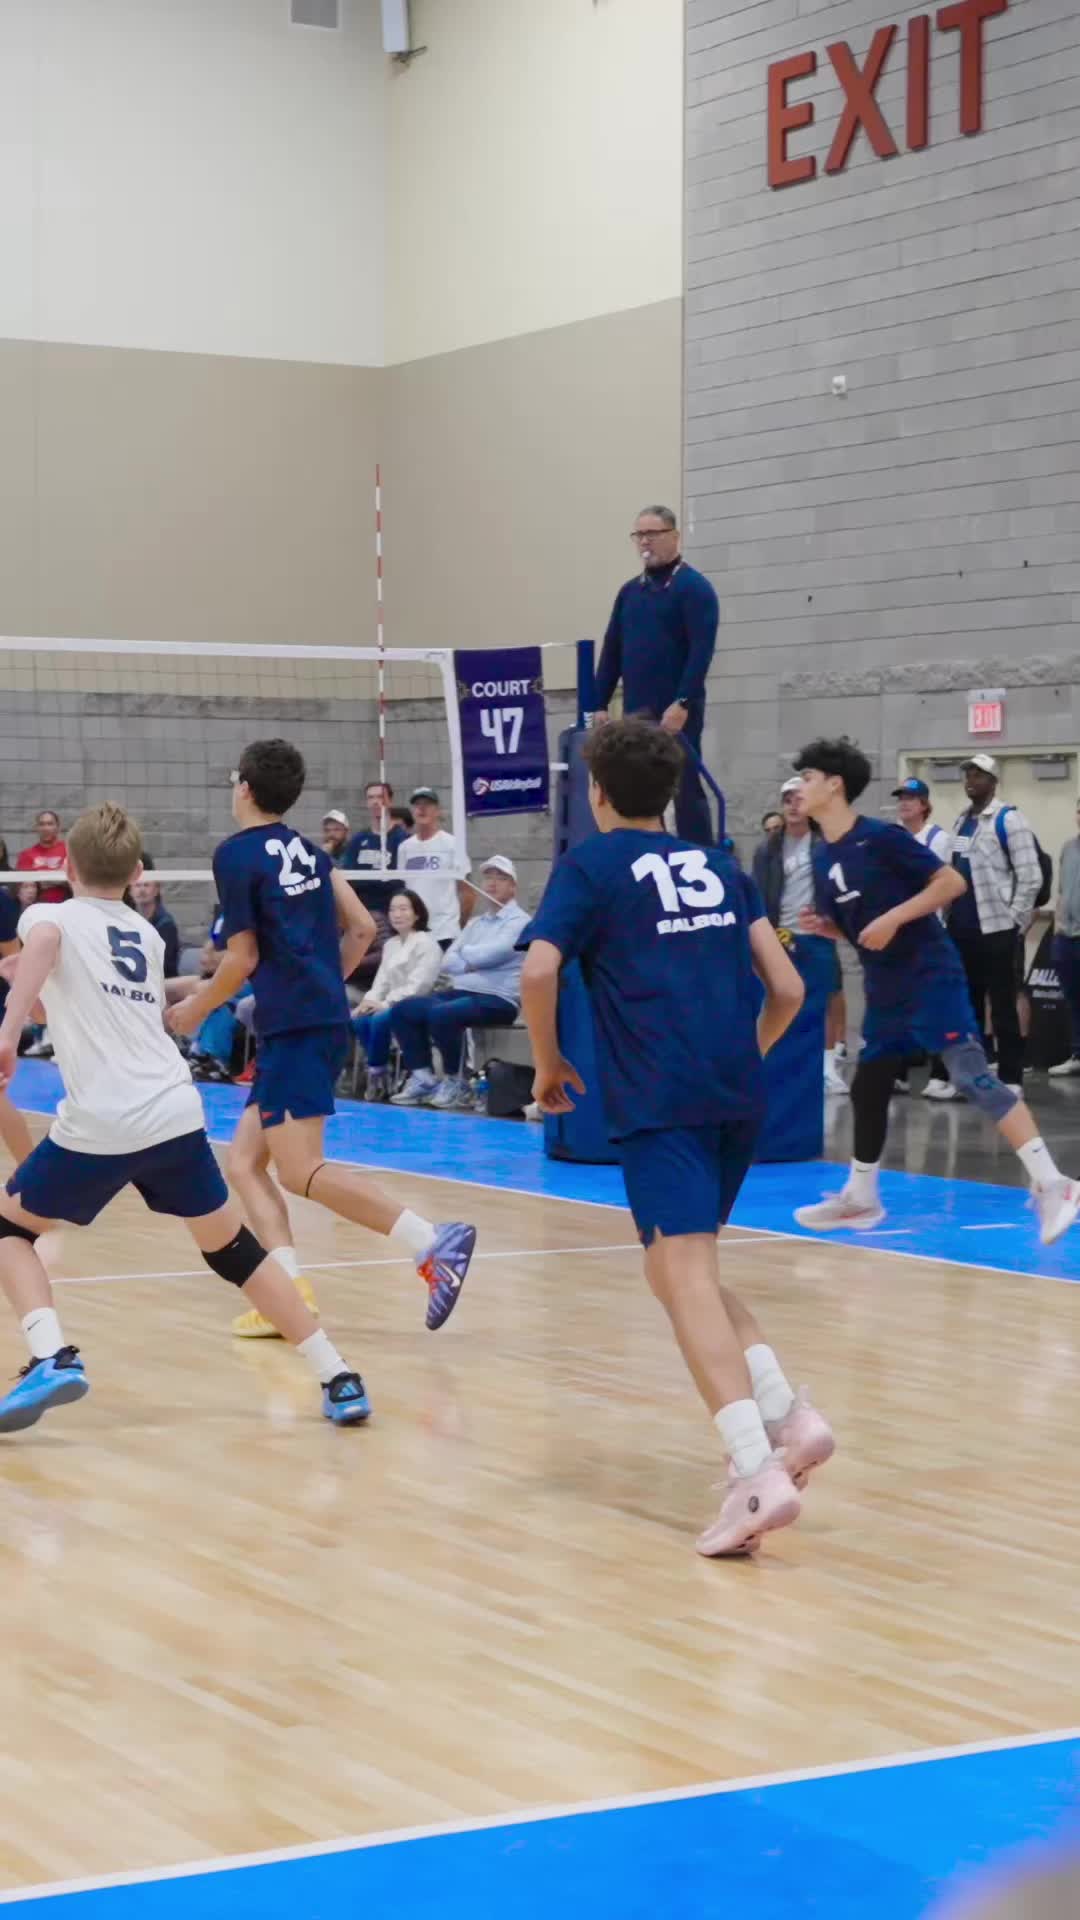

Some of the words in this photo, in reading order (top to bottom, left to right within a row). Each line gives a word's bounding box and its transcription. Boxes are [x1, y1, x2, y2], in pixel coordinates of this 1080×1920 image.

[767, 0, 1009, 191] EXIT
[472, 680, 531, 697] COURT
[480, 707, 524, 754] 47
[631, 850, 725, 912] 13
[656, 911, 736, 934] BALBOA
[106, 925, 148, 983] 5
